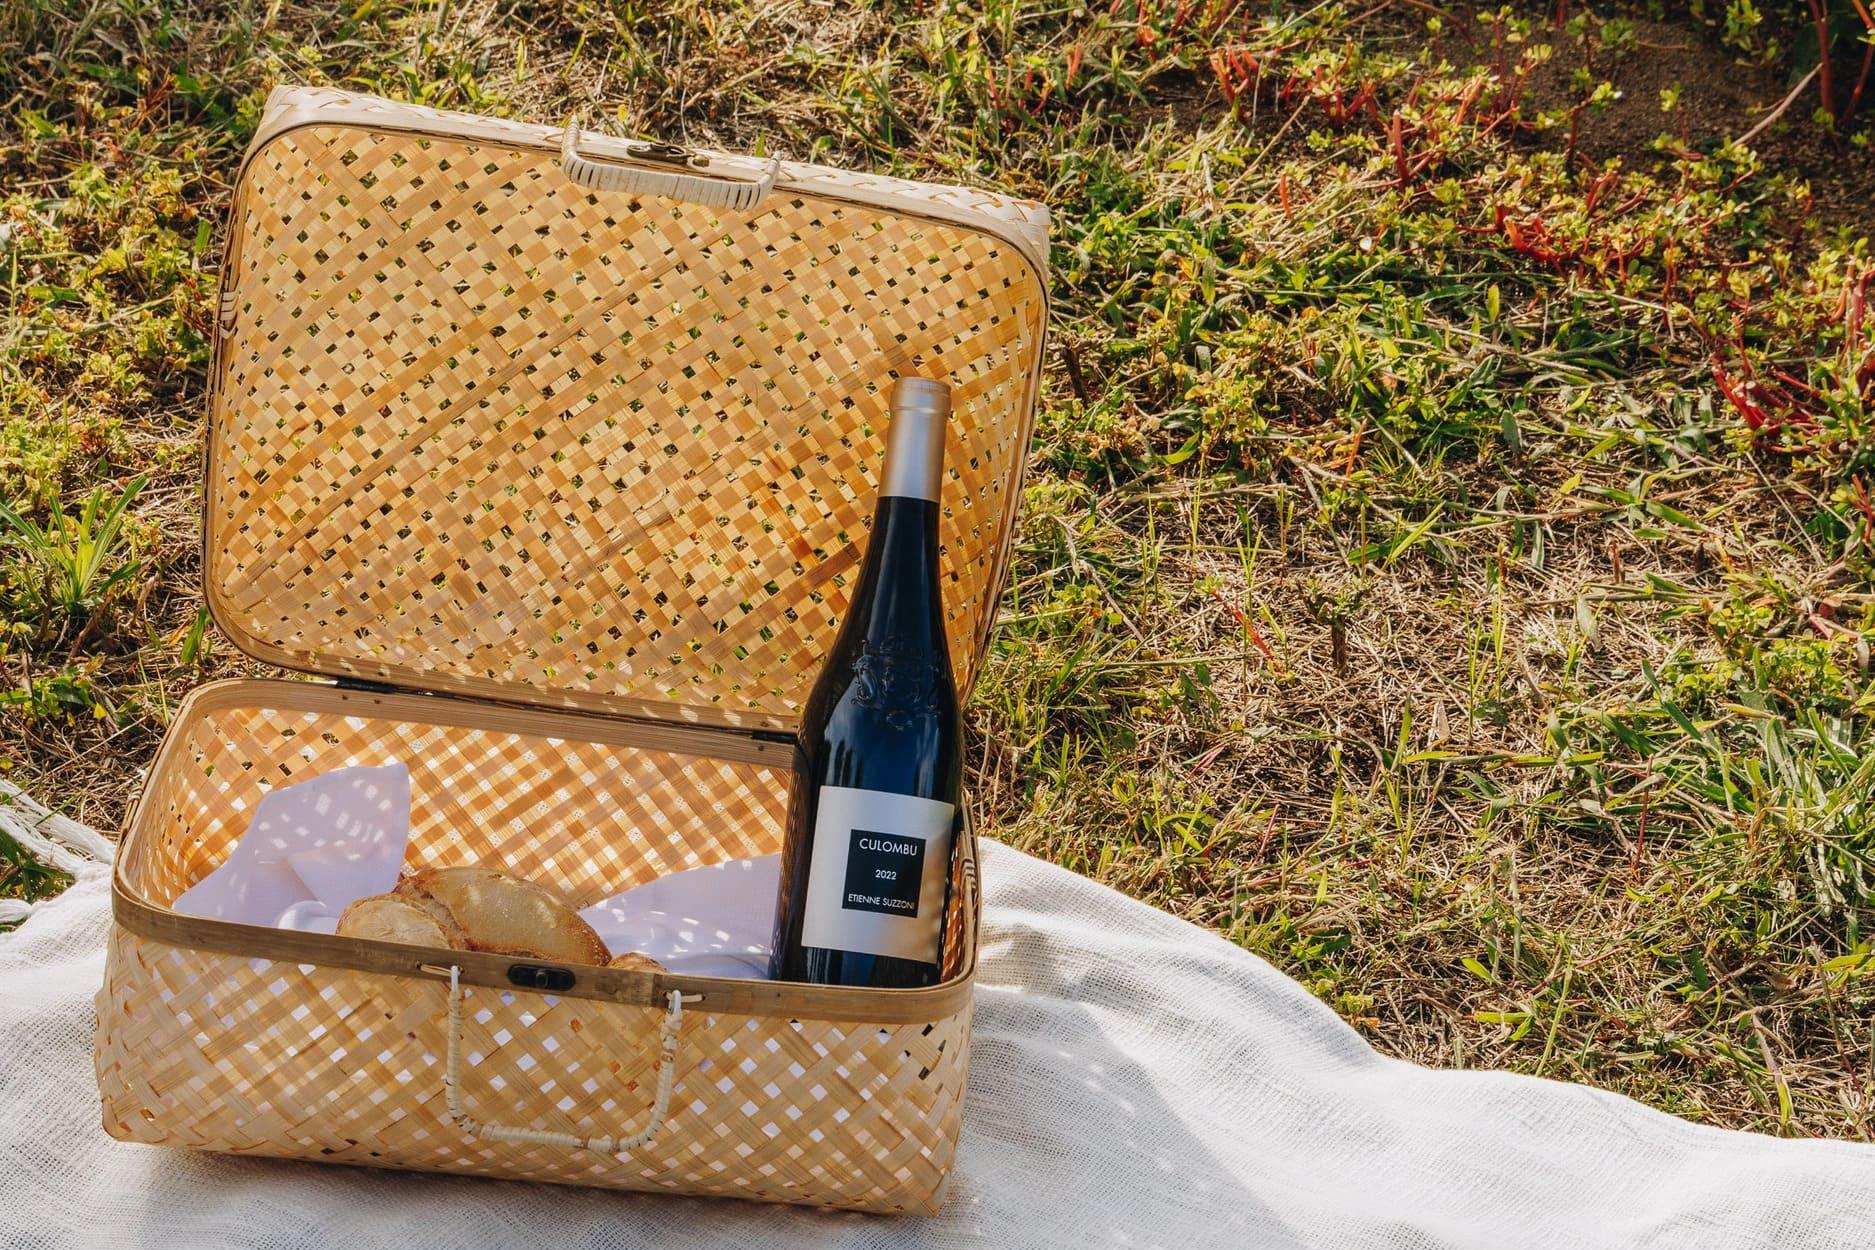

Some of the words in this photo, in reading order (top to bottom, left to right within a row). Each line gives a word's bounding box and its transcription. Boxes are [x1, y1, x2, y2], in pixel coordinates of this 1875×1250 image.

[859, 838, 918, 856] CULOMBU
[875, 869, 897, 880] 2022
[848, 893, 880, 905] ETIENNE
[882, 897, 915, 910] SUZZONI
